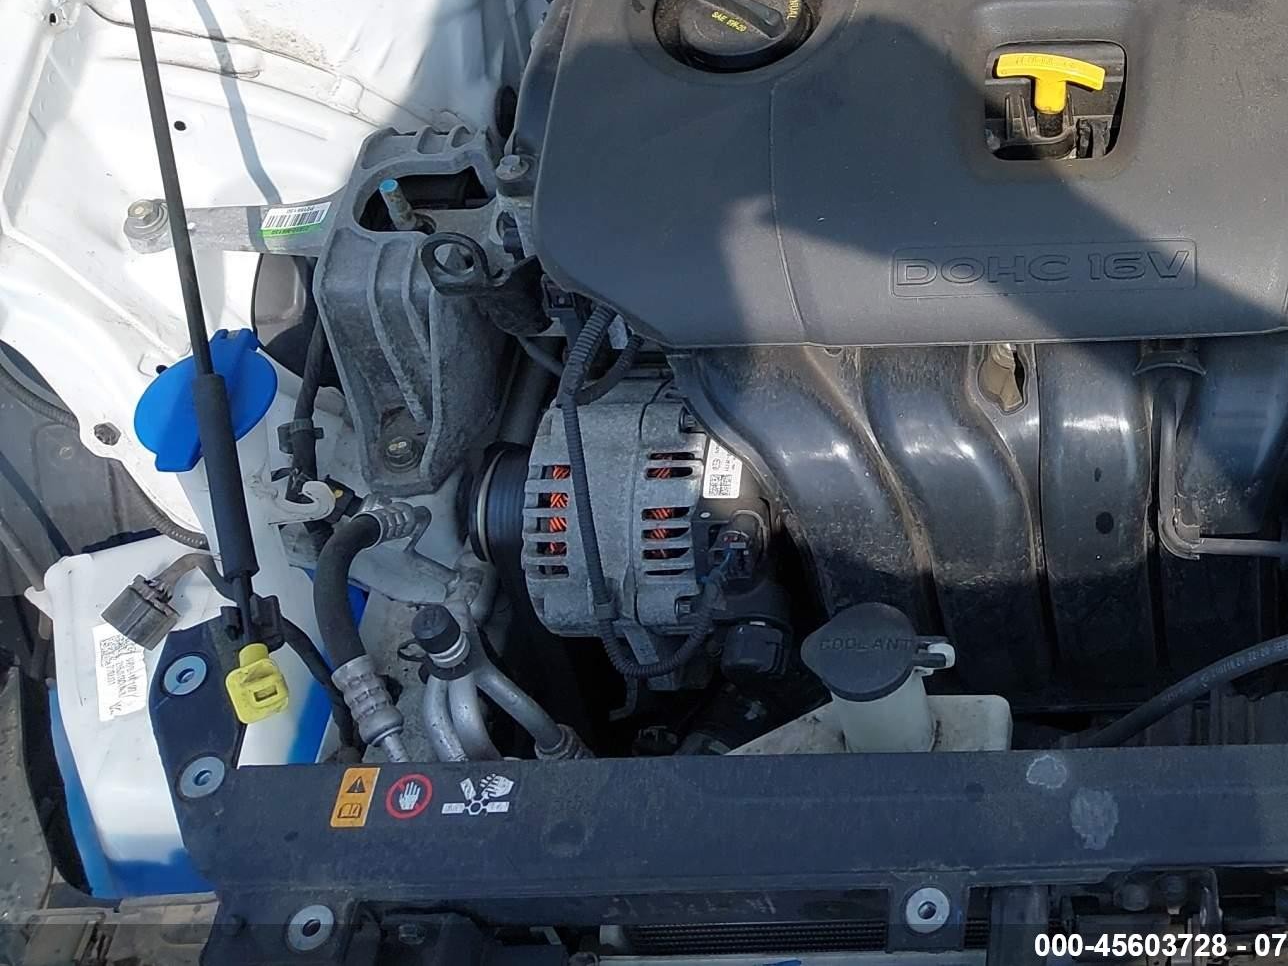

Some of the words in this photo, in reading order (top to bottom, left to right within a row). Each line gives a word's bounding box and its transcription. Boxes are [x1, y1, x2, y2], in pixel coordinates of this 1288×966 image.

[711, 11, 726, 22] SAE
[896, 254, 1071, 286] DOHC
[1087, 250, 1189, 280] 16V
[820, 636, 912, 652] COOLANT
